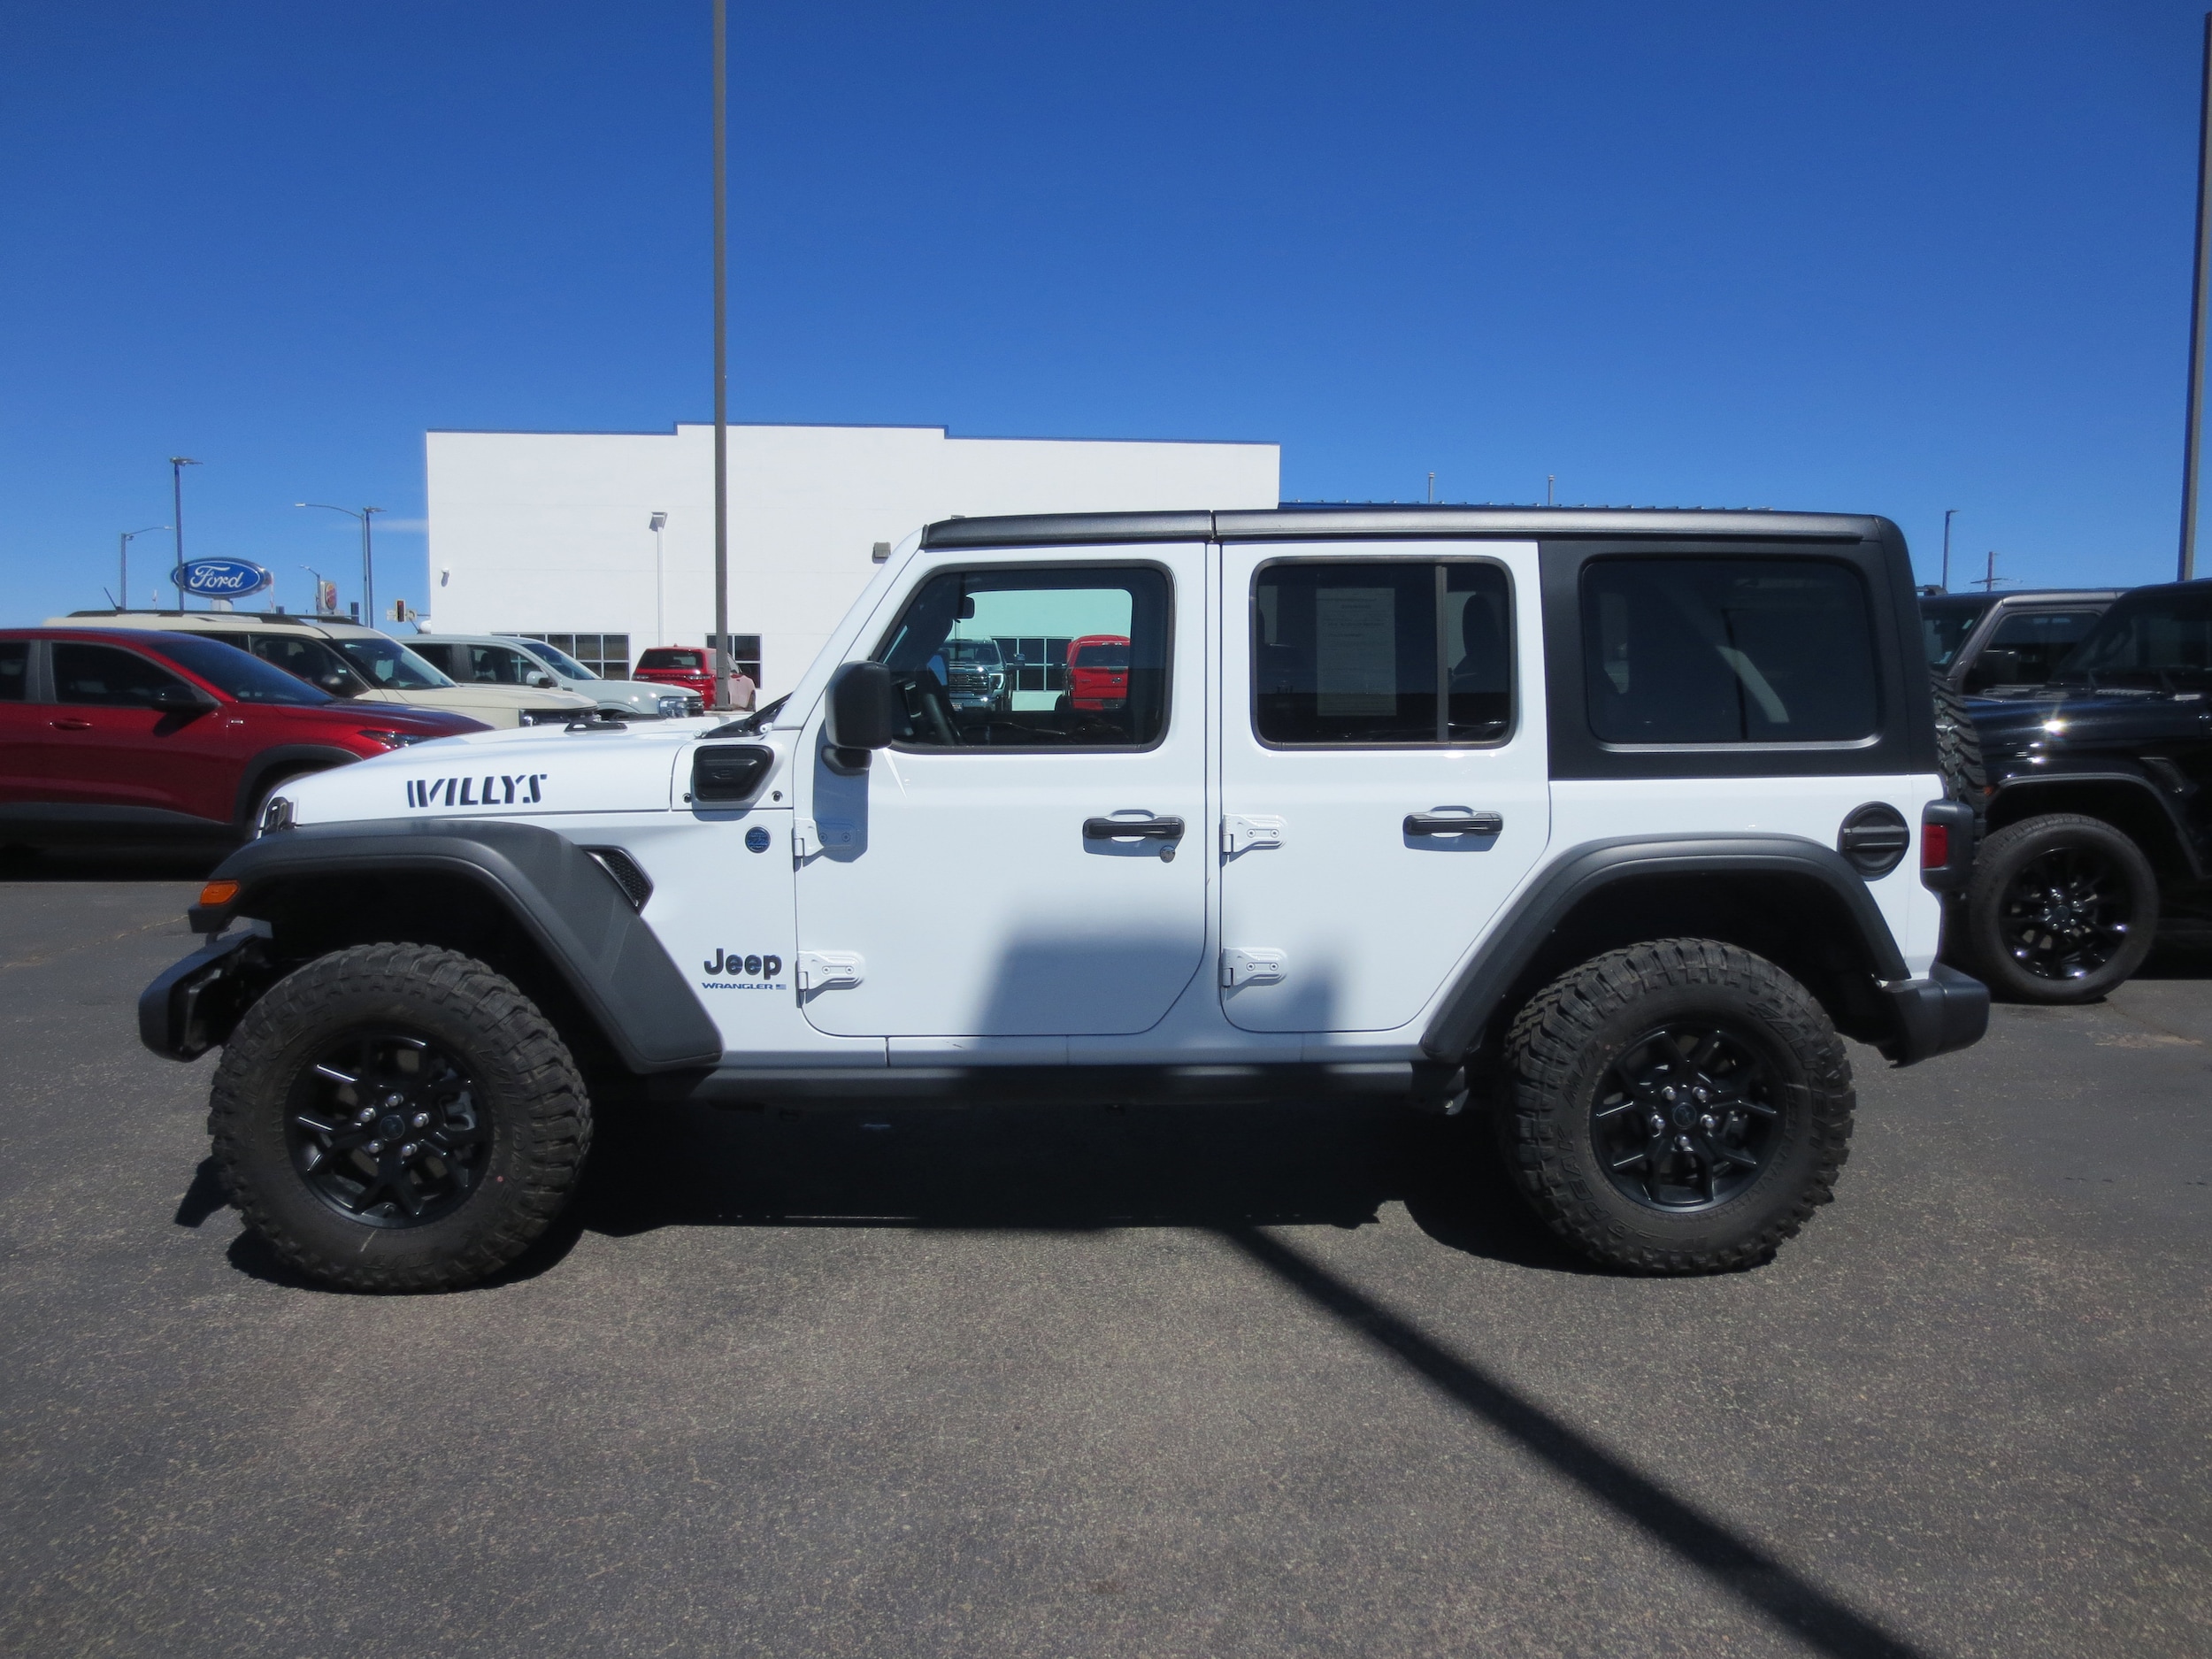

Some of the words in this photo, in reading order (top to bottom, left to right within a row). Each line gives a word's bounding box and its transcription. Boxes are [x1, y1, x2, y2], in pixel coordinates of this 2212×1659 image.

[189, 565, 244, 588] Ford
[407, 773, 548, 808] WILLYS
[703, 948, 782, 980] Jeep
